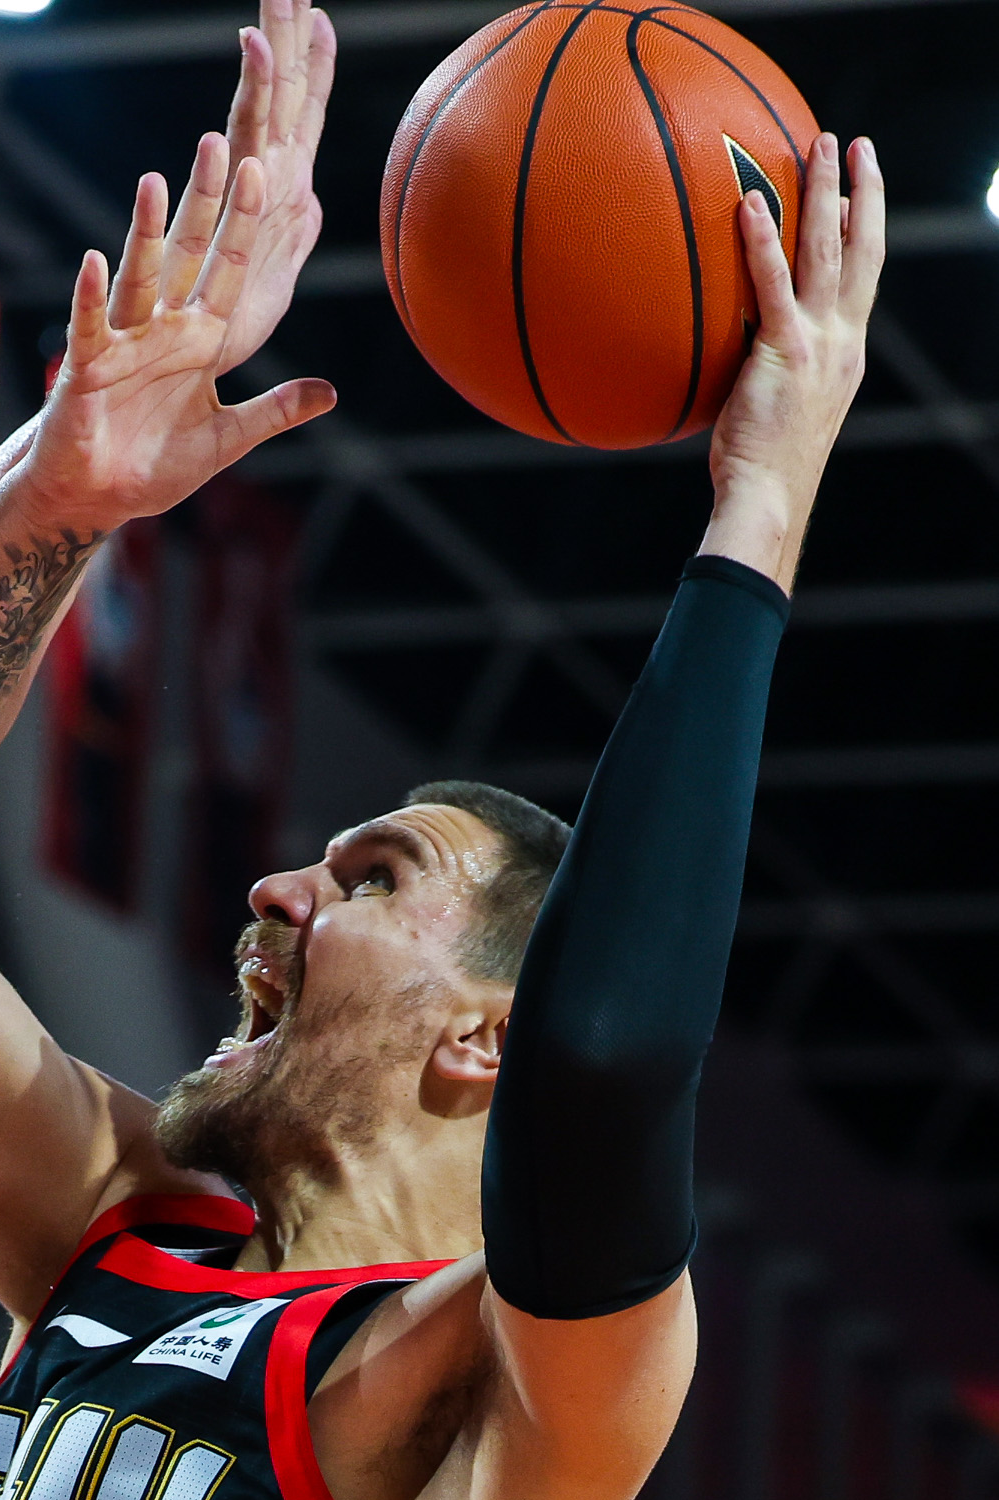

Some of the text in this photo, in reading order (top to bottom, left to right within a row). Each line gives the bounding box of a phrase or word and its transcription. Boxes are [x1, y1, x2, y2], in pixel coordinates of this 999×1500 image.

[159, 1335, 234, 1351] 中国人寿
[148, 1348, 223, 1365] CHINA LIFE
